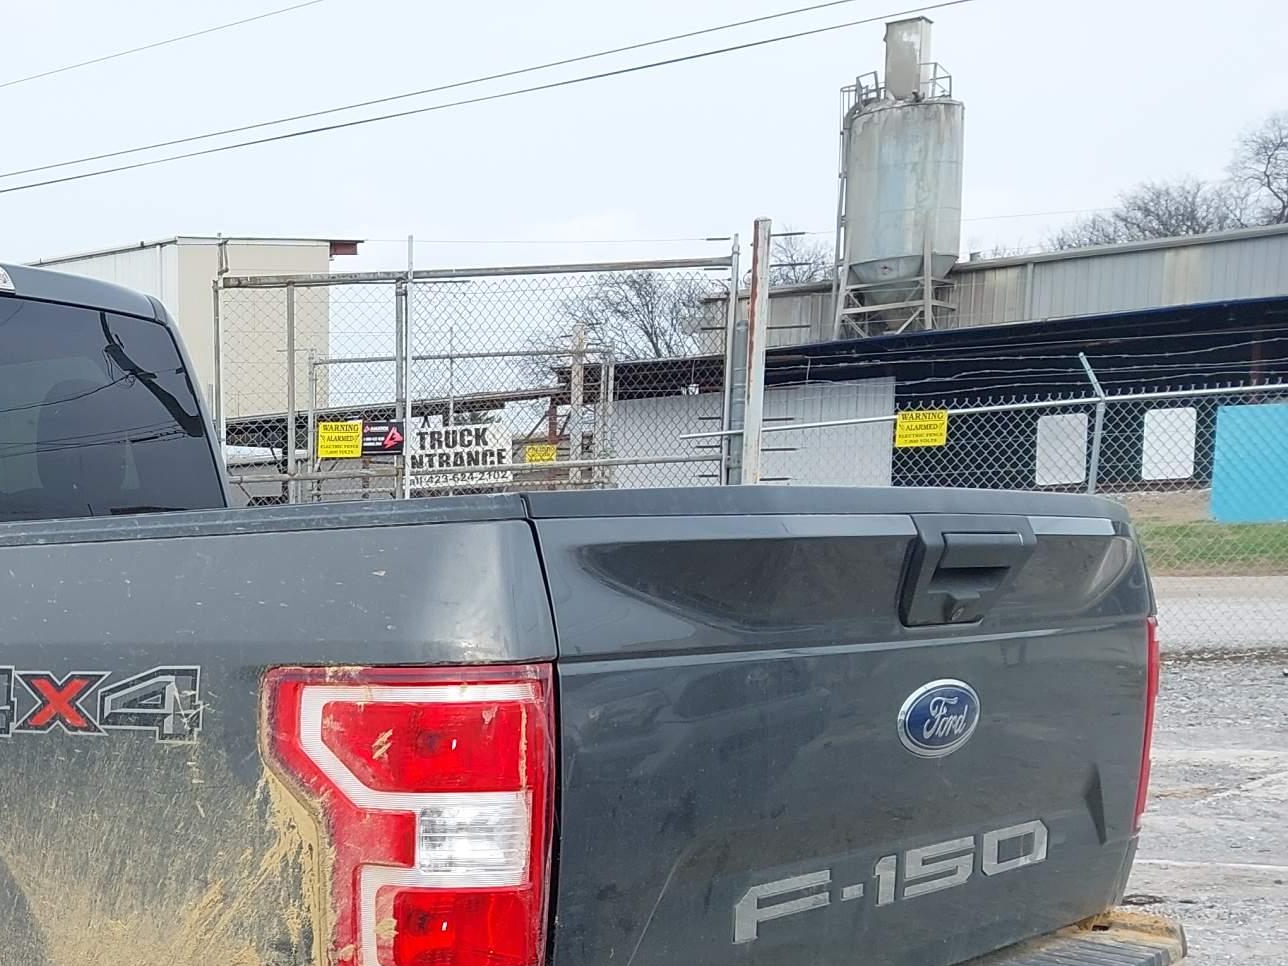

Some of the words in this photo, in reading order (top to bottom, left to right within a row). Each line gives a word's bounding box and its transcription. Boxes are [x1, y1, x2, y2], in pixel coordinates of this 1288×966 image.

[901, 412, 944, 420] WARNING
[322, 424, 359, 432] WARNING
[416, 428, 488, 450] TRUCK
[410, 449, 508, 469] NTRANCE
[922, 695, 969, 740] Ford
[733, 818, 1049, 944] F-150
